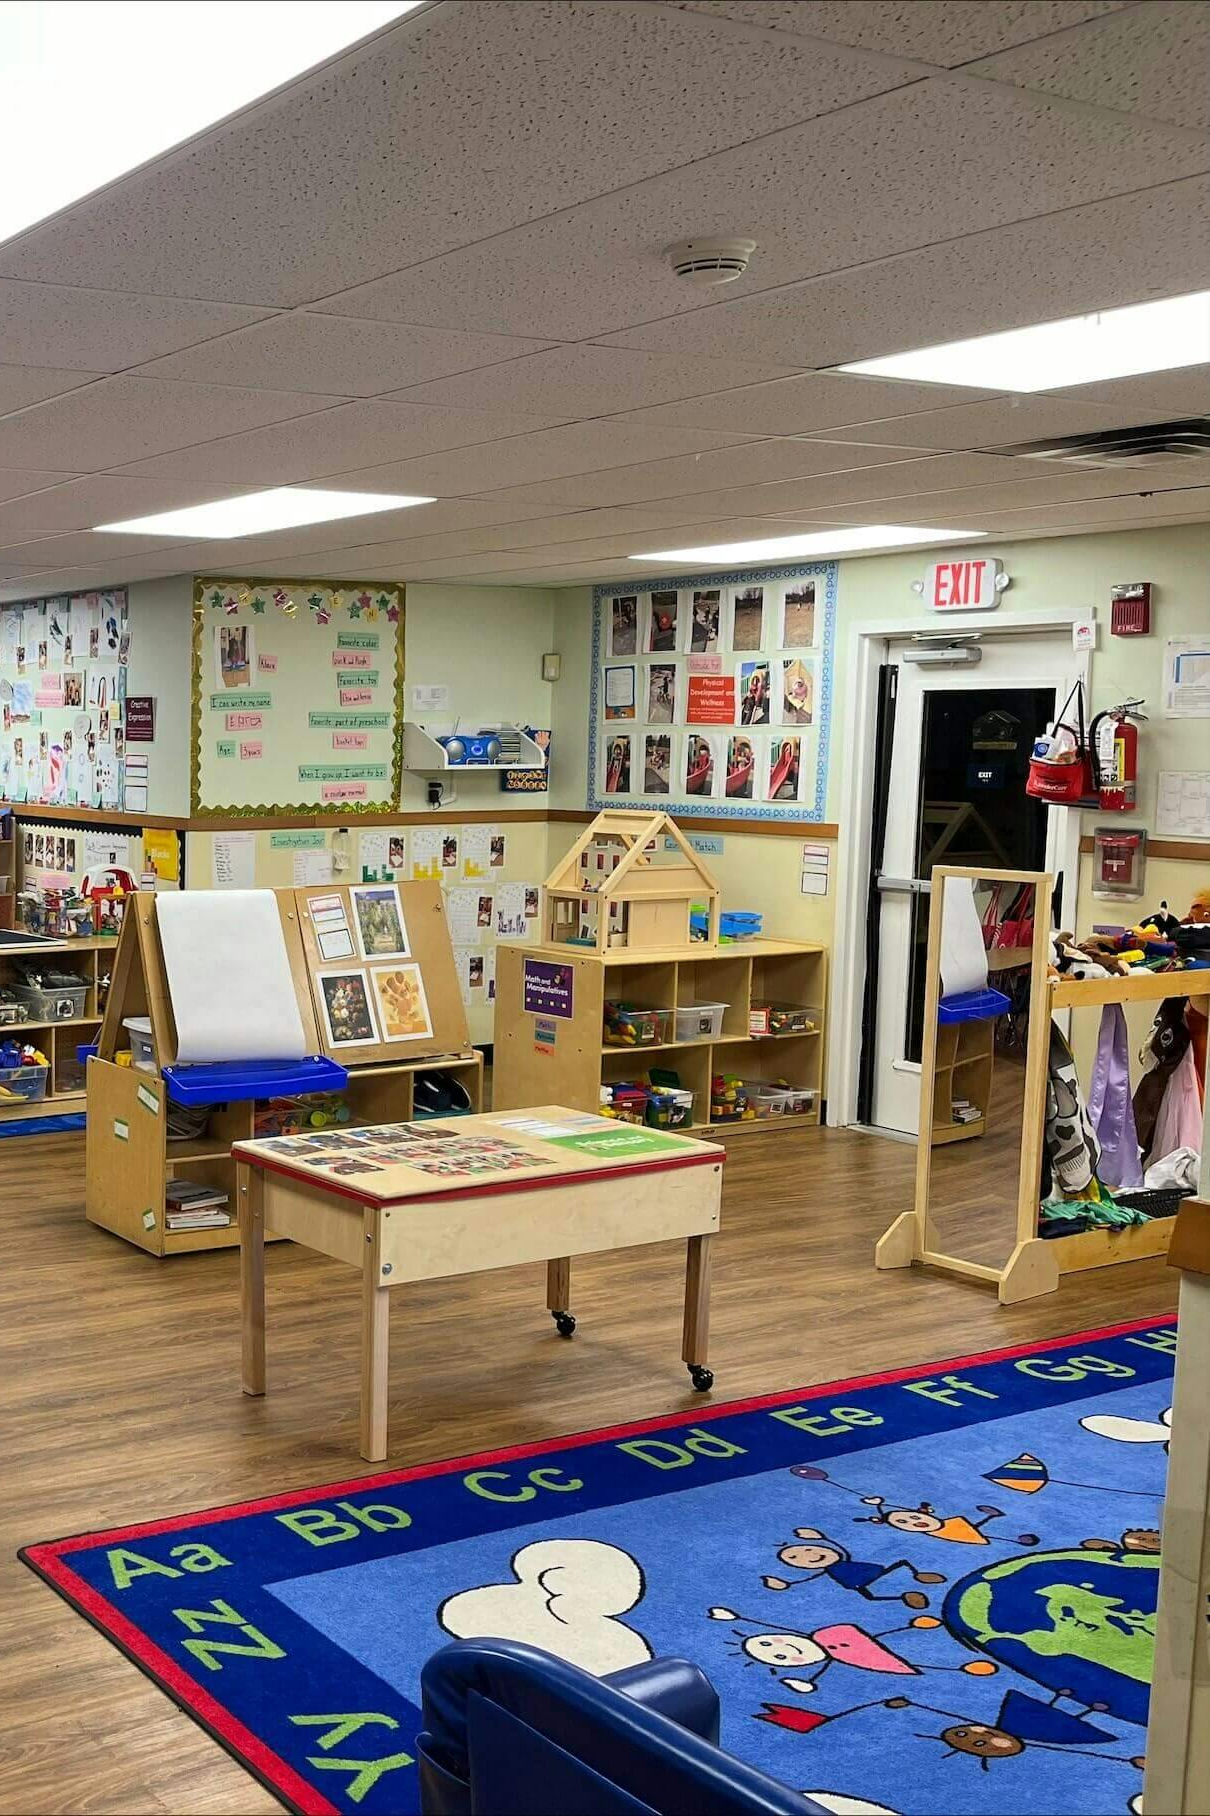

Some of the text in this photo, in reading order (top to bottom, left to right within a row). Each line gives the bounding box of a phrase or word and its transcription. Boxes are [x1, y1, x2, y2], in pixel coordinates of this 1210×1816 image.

[934, 561, 986, 606] EXIT
[1117, 624, 1136, 632] FIRE
[690, 689, 724, 697] Development
[702, 679, 724, 687] Physical
[128, 712, 151, 723] Expression
[130, 700, 149, 709] Creative
[525, 974, 541, 983] Math
[526, 982, 568, 996] Manipulatives
[1124, 1329, 1178, 1356] H
[1013, 1355, 1136, 1382] Gg
[902, 1375, 999, 1407] Ff
[769, 1406, 884, 1437] Ee
[615, 1429, 749, 1470] Dd
[463, 1468, 584, 1503] Cc
[274, 1502, 413, 1547] Bb
[107, 1541, 234, 1590] Aa
[172, 1598, 288, 1671] Zz
[288, 1711, 415, 1803] Yy
